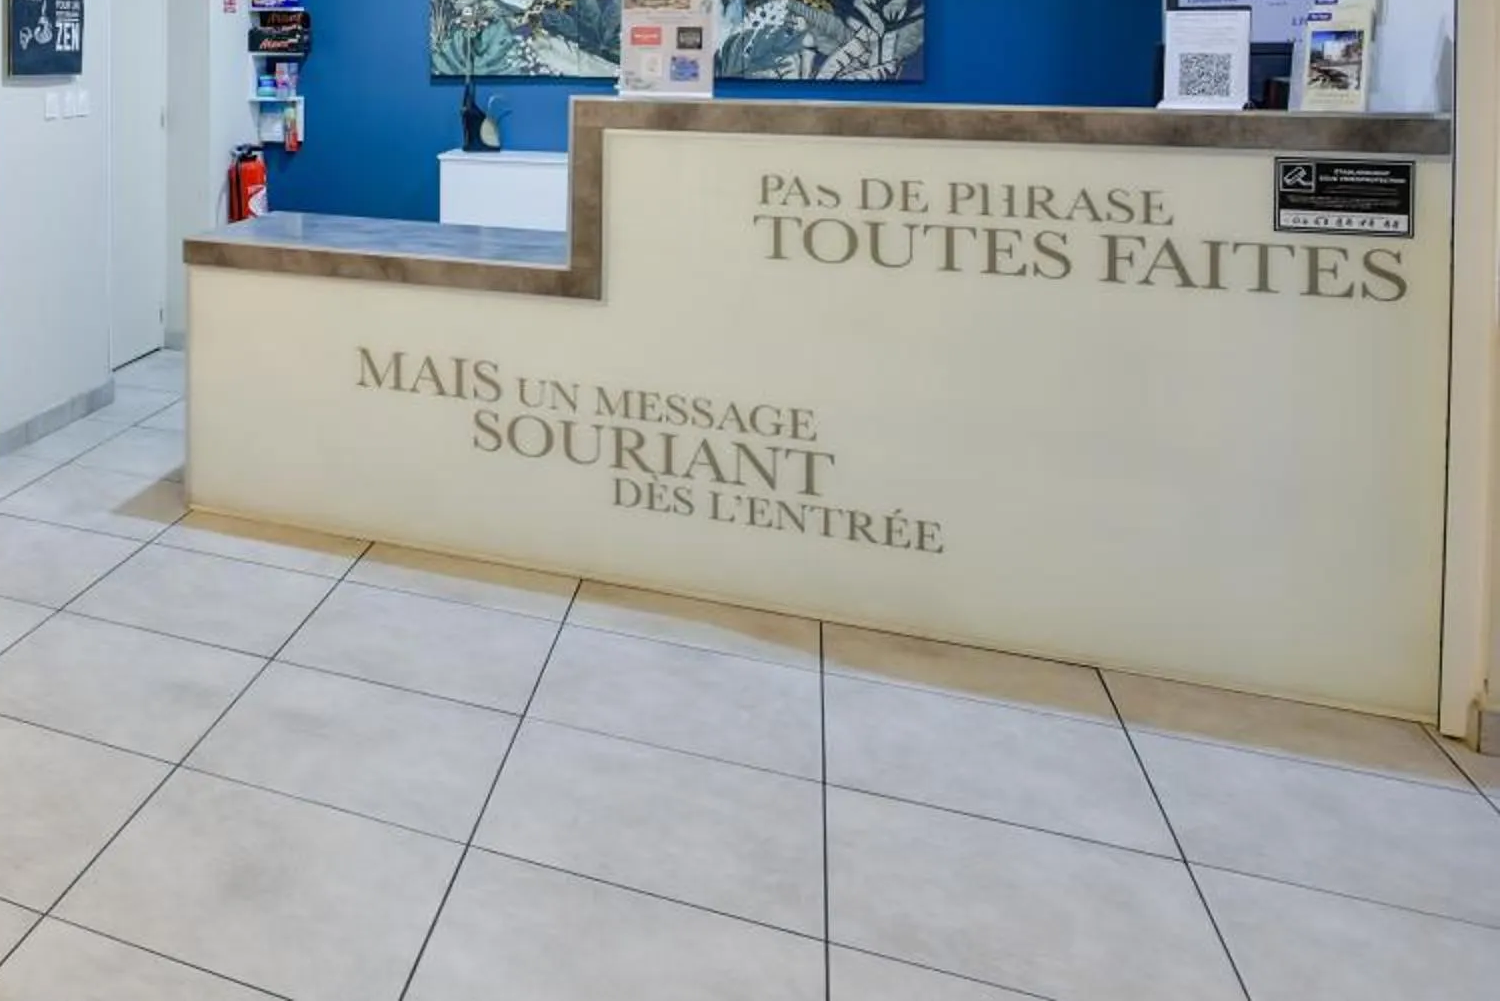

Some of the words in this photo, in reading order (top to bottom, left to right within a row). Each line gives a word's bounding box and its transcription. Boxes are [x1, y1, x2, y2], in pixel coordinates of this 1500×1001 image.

[55, 22, 80, 51] ZEN
[758, 174, 841, 209] PAS
[857, 178, 929, 213] DE
[947, 182, 1175, 227] PHRASE
[753, 215, 1072, 280] TOUTES
[1099, 233, 1408, 302] FAITES
[356, 346, 503, 403] MAIS
[516, 377, 580, 413] UN
[594, 386, 818, 442] MESSAGE
[473, 409, 836, 498] SOURIANT
[611, 473, 695, 517] DÈS
[708, 490, 944, 555] L'ENTRÉE
